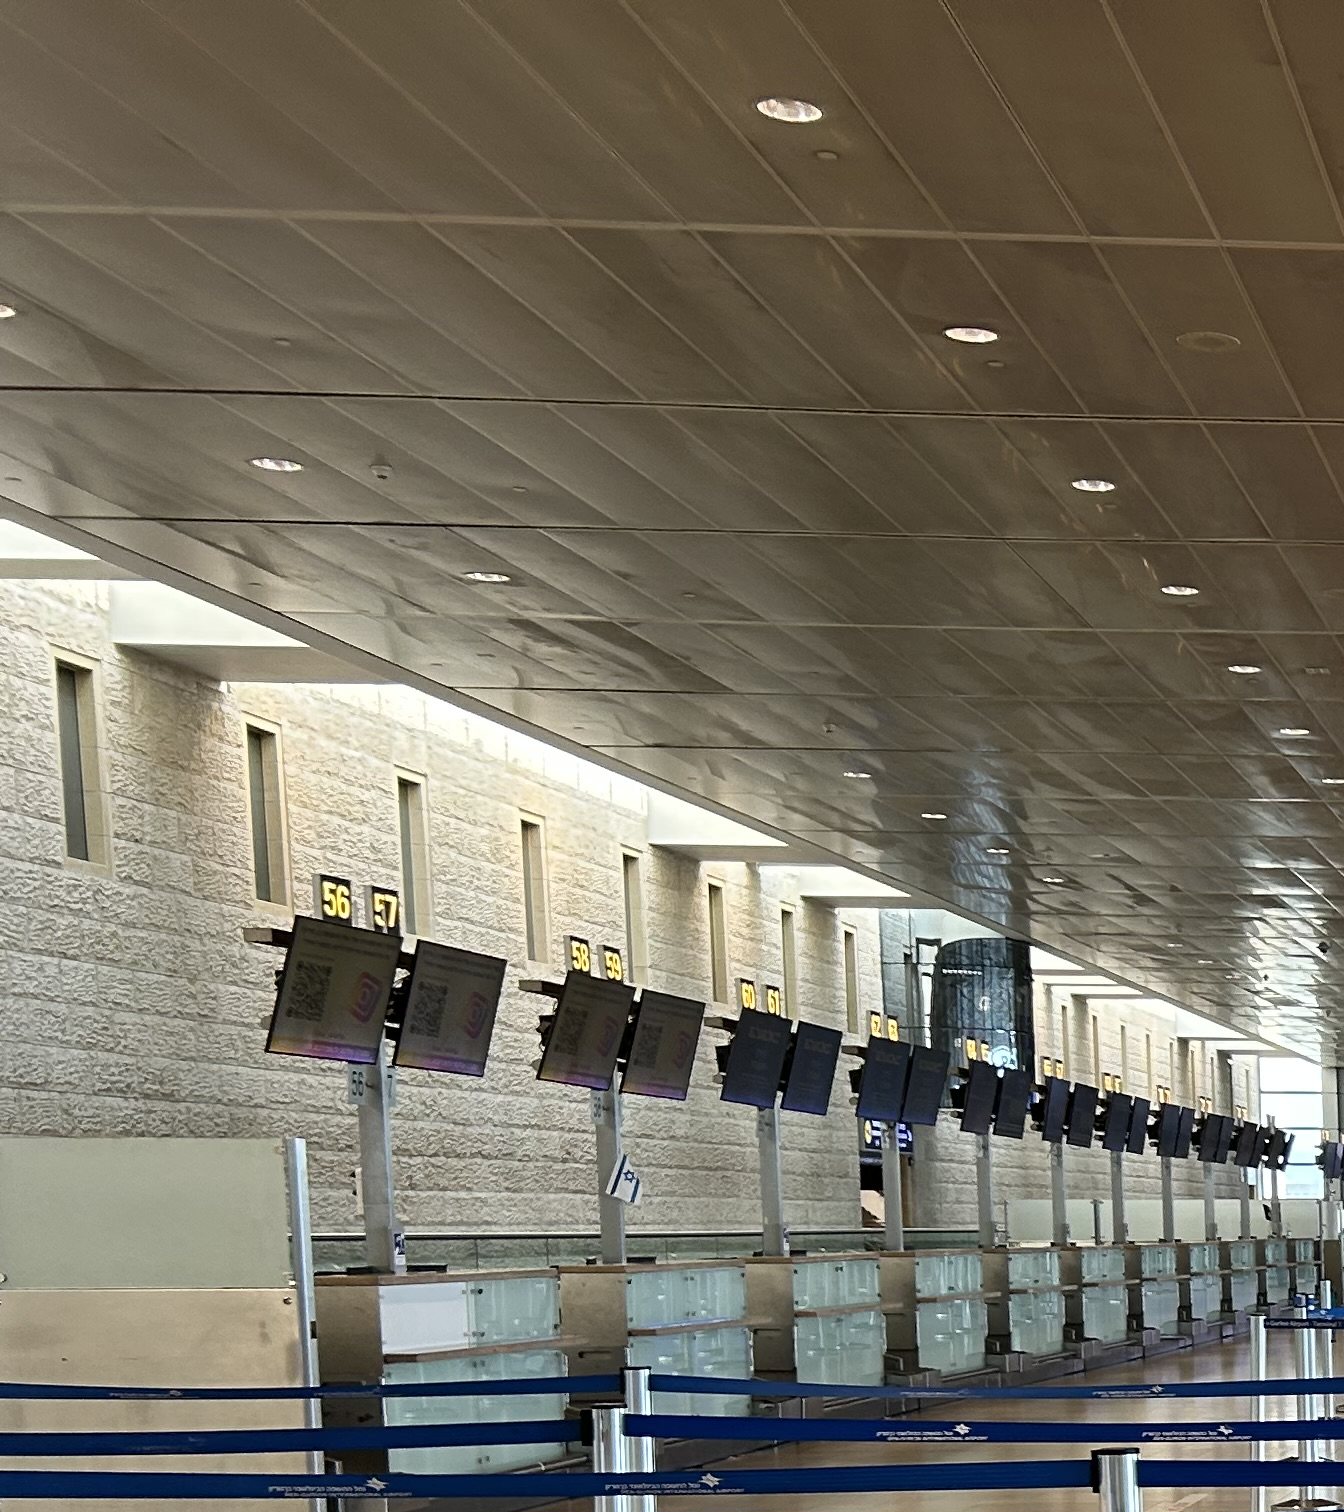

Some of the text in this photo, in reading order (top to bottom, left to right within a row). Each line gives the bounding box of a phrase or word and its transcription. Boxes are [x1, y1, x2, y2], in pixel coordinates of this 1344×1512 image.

[323, 881, 350, 919] 56
[374, 893, 397, 927] 57
[572, 940, 589, 971] 58
[604, 951, 621, 980] 59
[352, 1071, 364, 1096] 56
